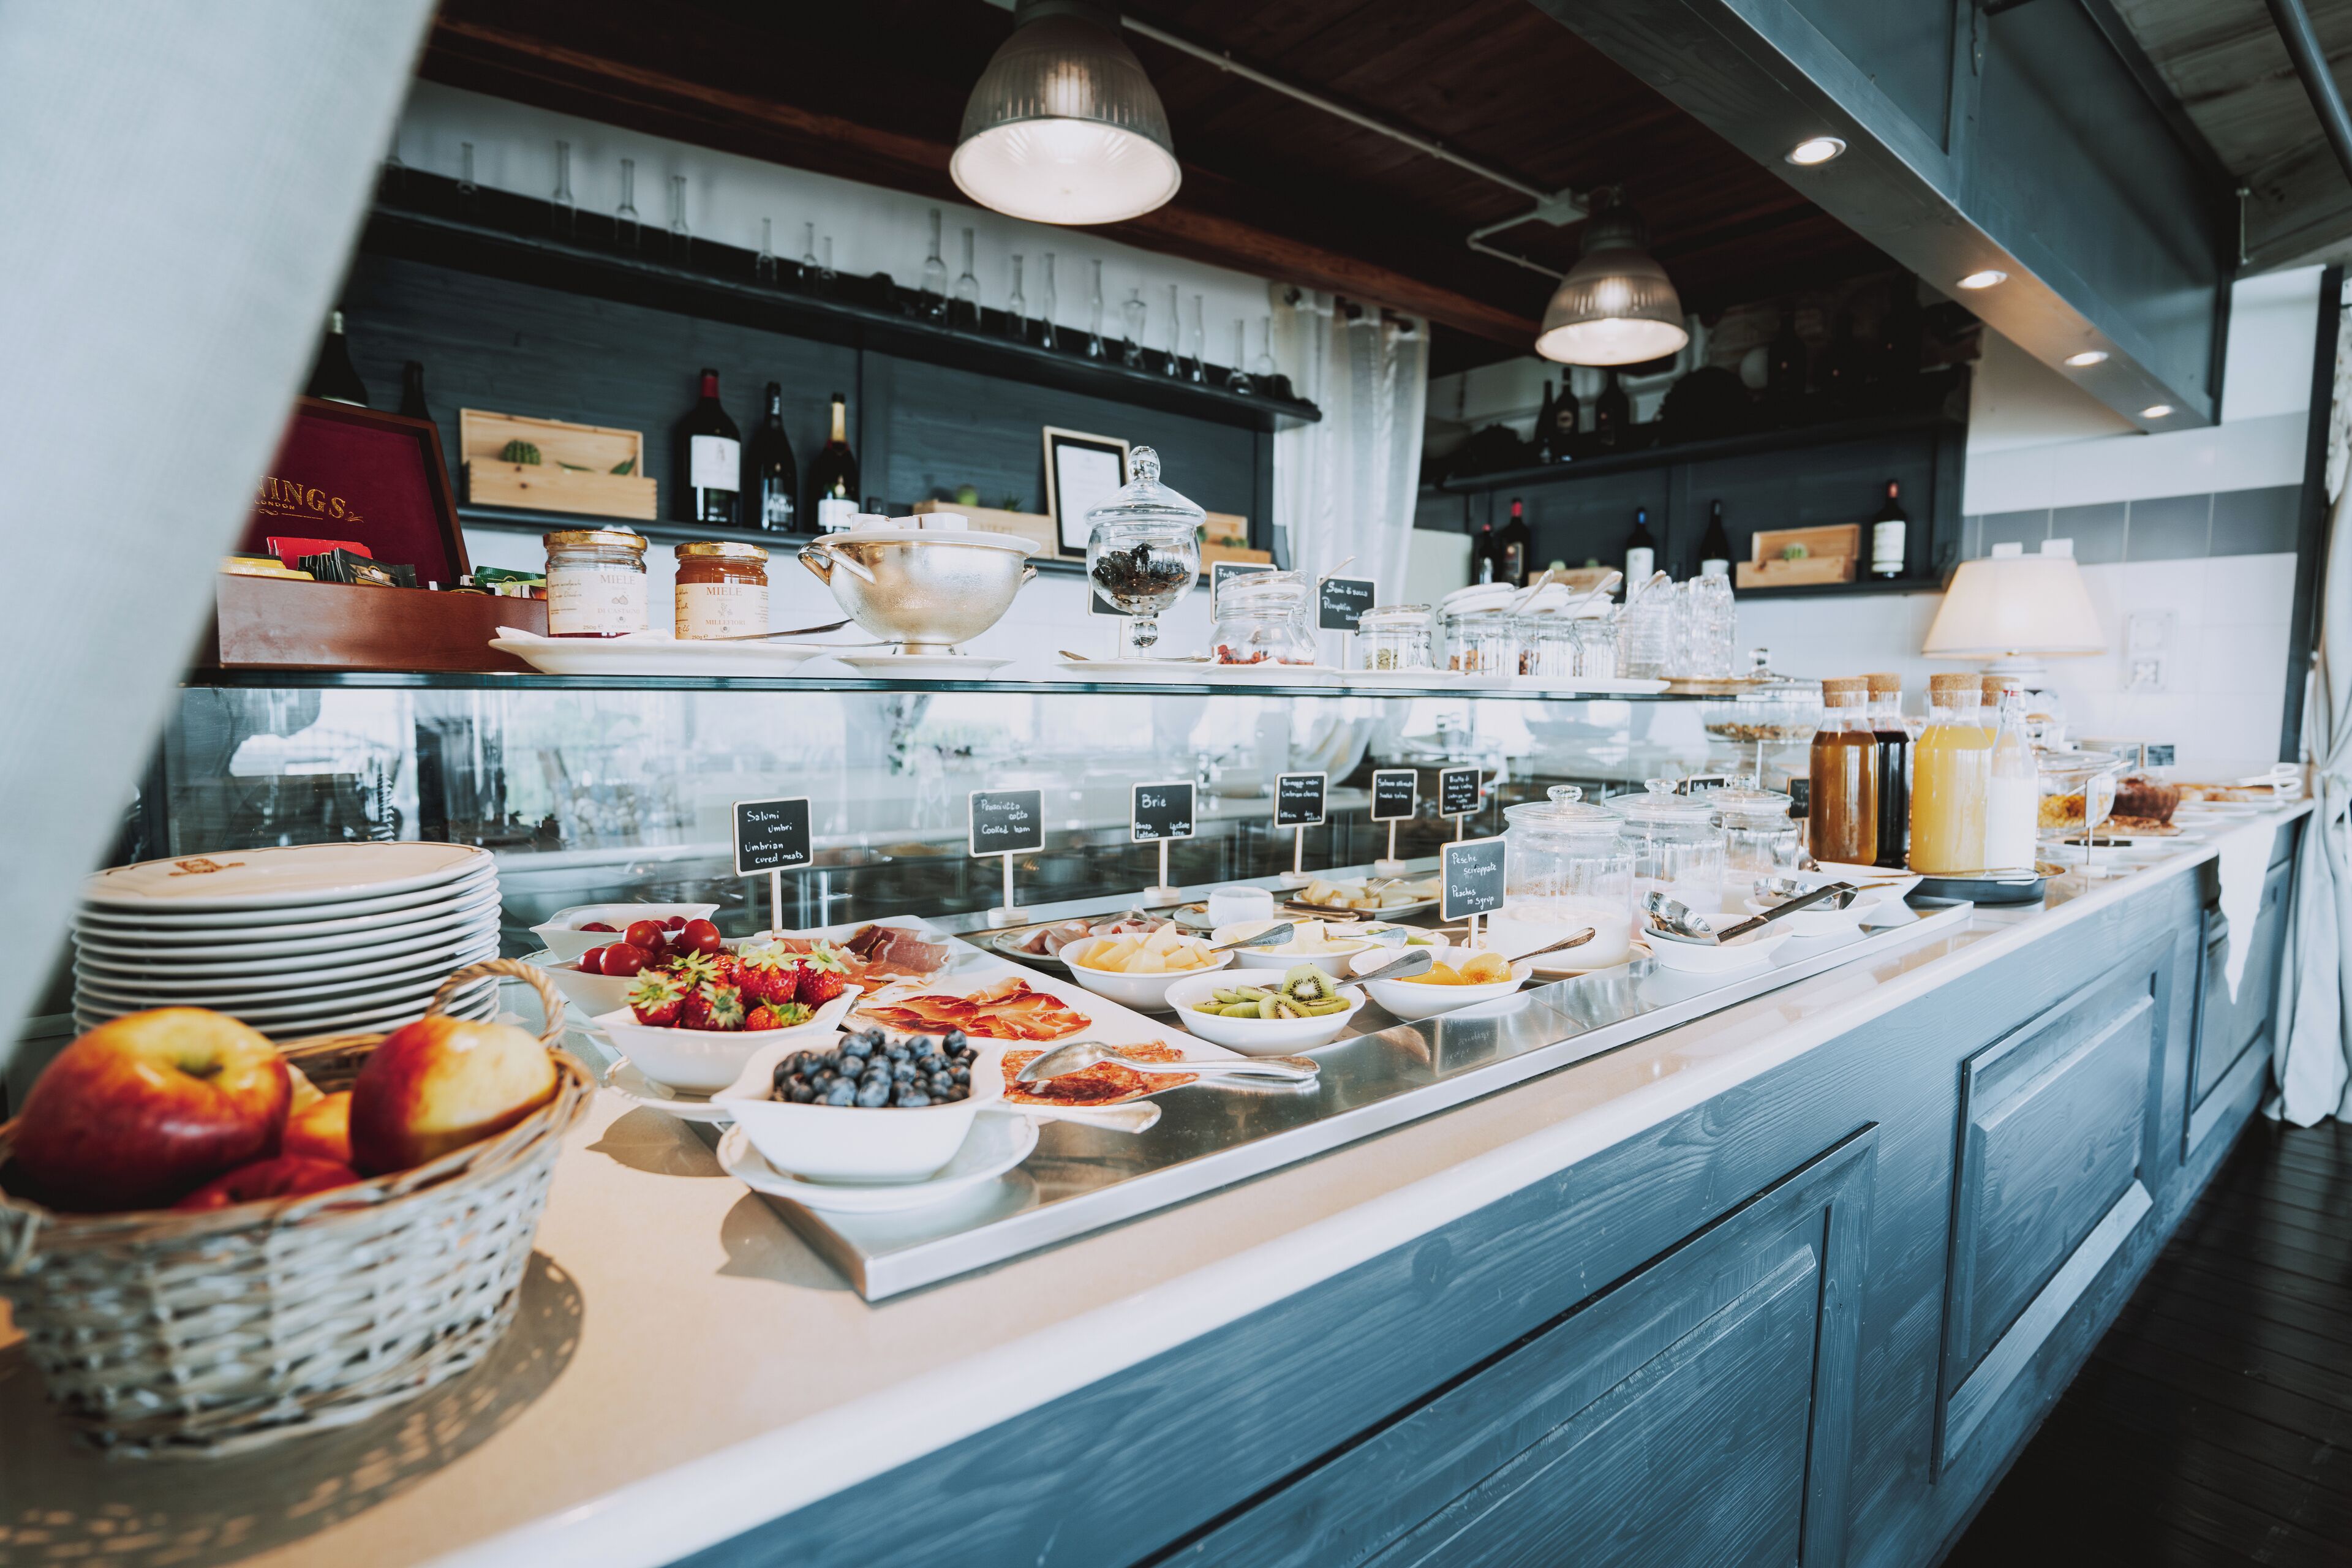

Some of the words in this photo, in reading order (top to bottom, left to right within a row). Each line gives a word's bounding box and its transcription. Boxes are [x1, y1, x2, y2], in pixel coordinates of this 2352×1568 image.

[254, 499, 295, 510] LONDON
[601, 575, 636, 585] MIELE
[706, 587, 742, 596] MIELE
[1322, 596, 1351, 612] Pumpkin
[1345, 612, 1359, 621] seed
[981, 799, 1020, 810] Prosciutto
[1142, 794, 1166, 808] Brie
[747, 810, 779, 822] Salumi
[1009, 810, 1028, 820] cotto
[745, 840, 783, 853] Umbrian
[755, 853, 778, 864] cured
[783, 850, 804, 860] meats
[1452, 852, 1477, 865] Pesche
[1463, 862, 1496, 876] sciroppate
[1452, 885, 1476, 897] Peaches
[1467, 897, 1473, 905] in
